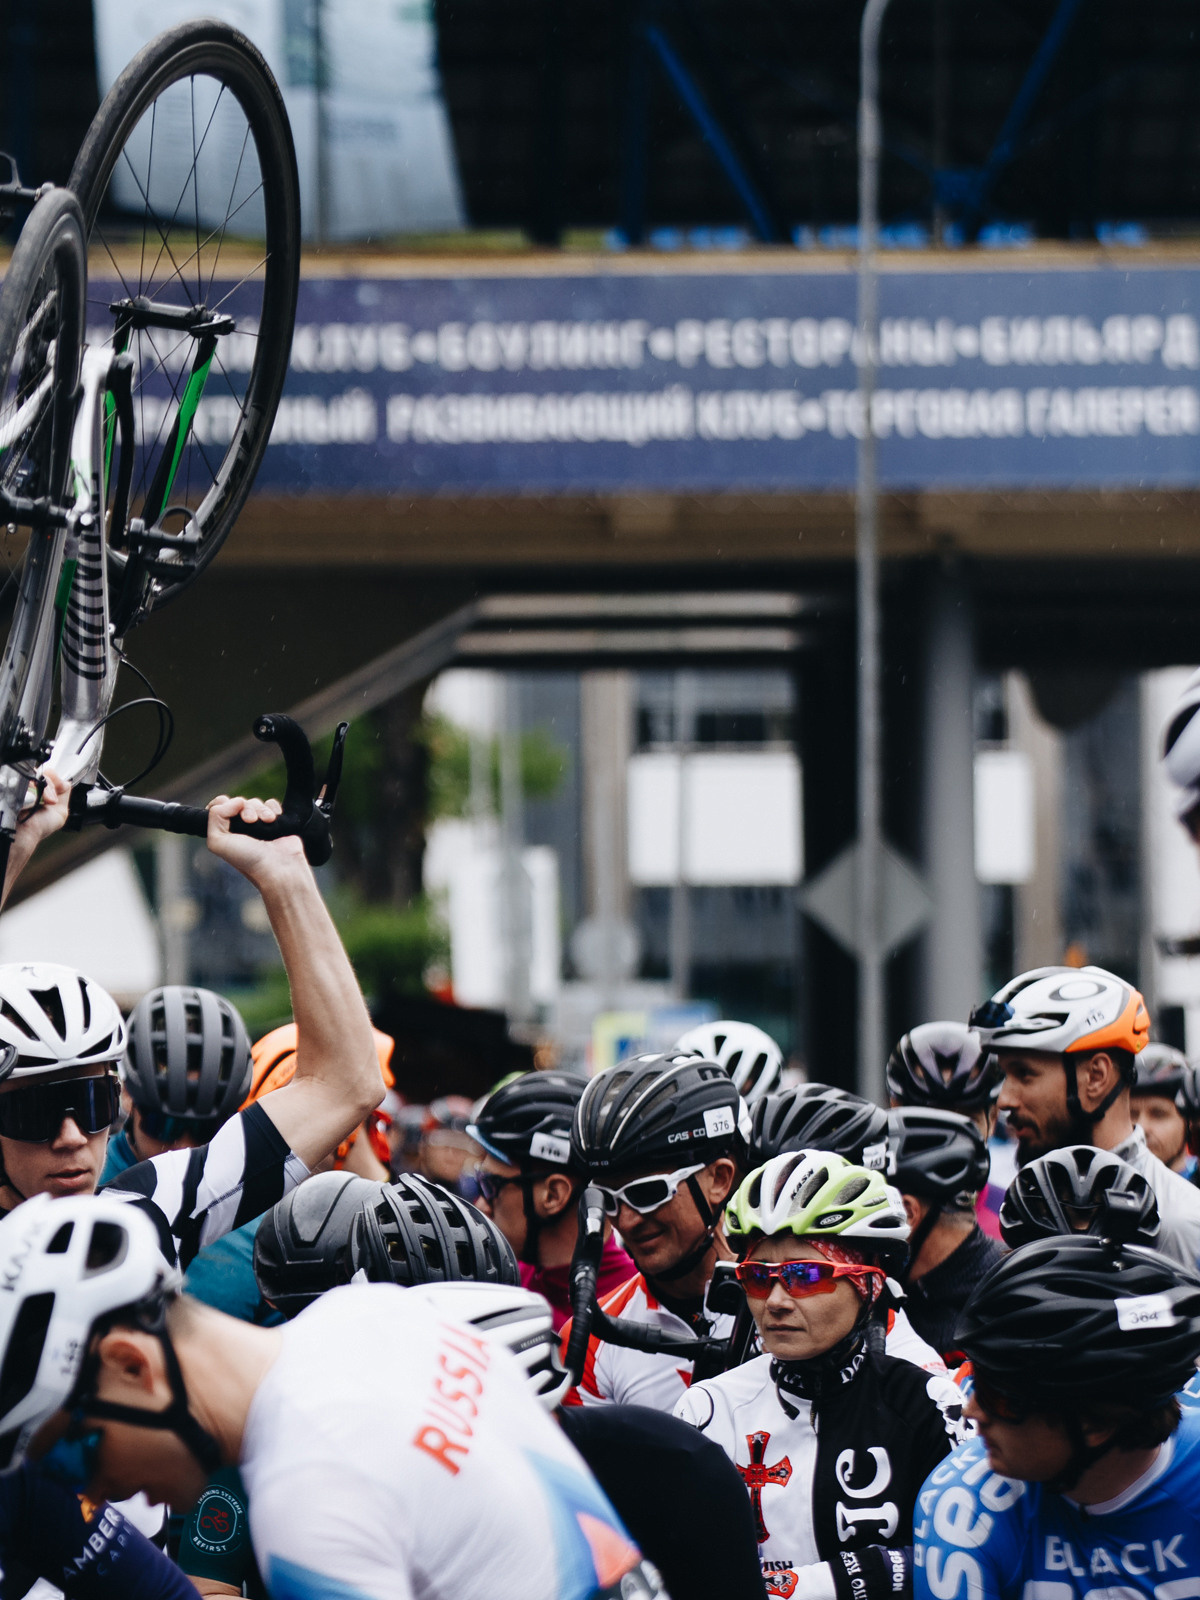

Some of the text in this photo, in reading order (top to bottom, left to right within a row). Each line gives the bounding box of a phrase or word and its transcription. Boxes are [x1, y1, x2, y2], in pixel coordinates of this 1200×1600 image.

[713, 1121, 730, 1133] 376
[412, 1321, 491, 1477] RUSSIA
[221, 1489, 243, 1515] SYSTEMS
[914, 1447, 979, 1568] BLACK
[192, 1535, 227, 1552] BEFIRST
[1045, 1534, 1187, 1578] BLACK
